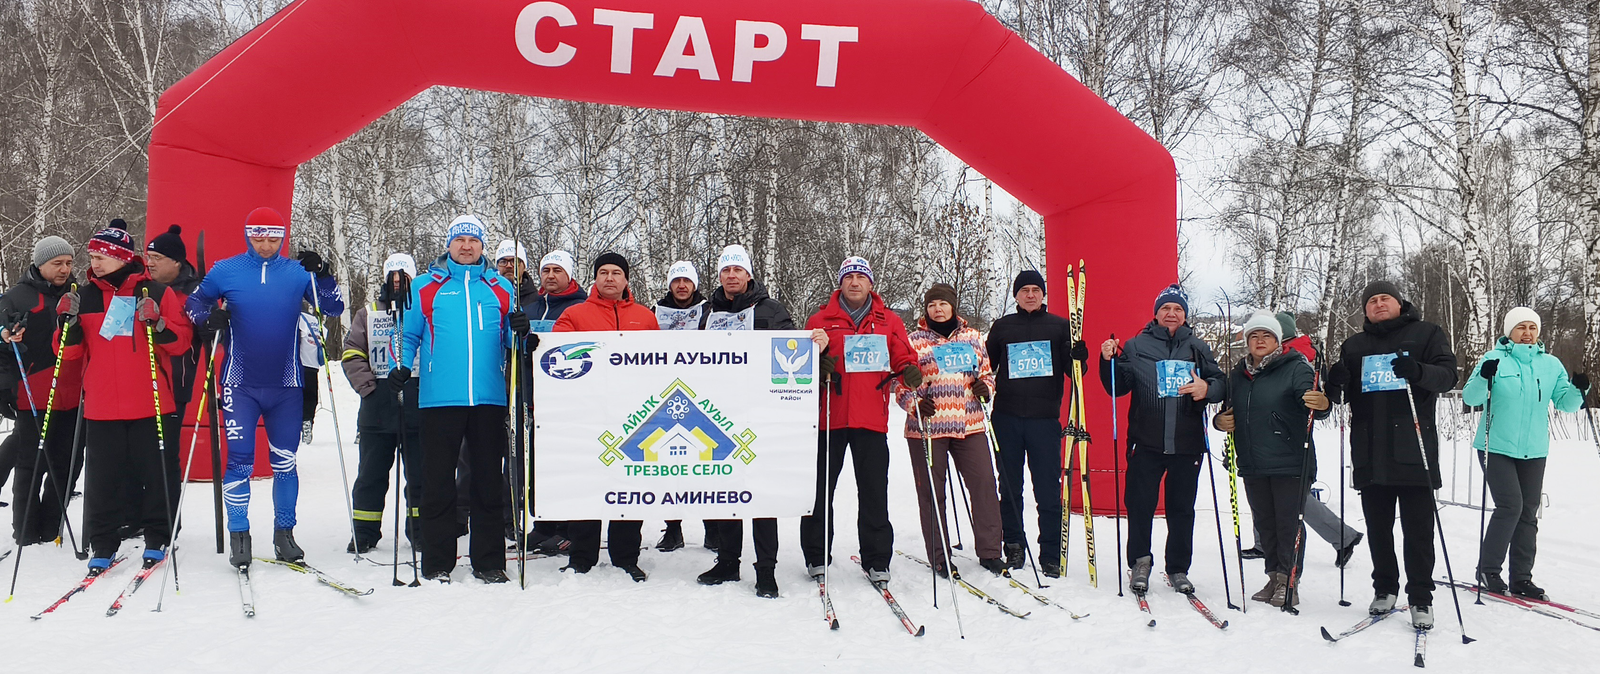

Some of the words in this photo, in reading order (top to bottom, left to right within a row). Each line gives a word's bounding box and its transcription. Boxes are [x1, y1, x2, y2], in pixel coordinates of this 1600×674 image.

[514, 1, 859, 88] СТАРТ
[609, 352, 668, 366] ӘМИН
[673, 351, 748, 365] АУЫЛЫ
[852, 351, 881, 364] 5787
[944, 353, 972, 367] 5713
[1018, 357, 1045, 371] 5791
[698, 399, 734, 431] АУЫЛ
[225, 419, 244, 440] ski
[624, 464, 688, 476] ТРЕЗВОЕ
[692, 464, 733, 475] СЕЛО
[604, 491, 656, 505] СЕЛО
[661, 490, 753, 505] АМИНЕВО
[1086, 526, 1096, 567] ACTIVE
